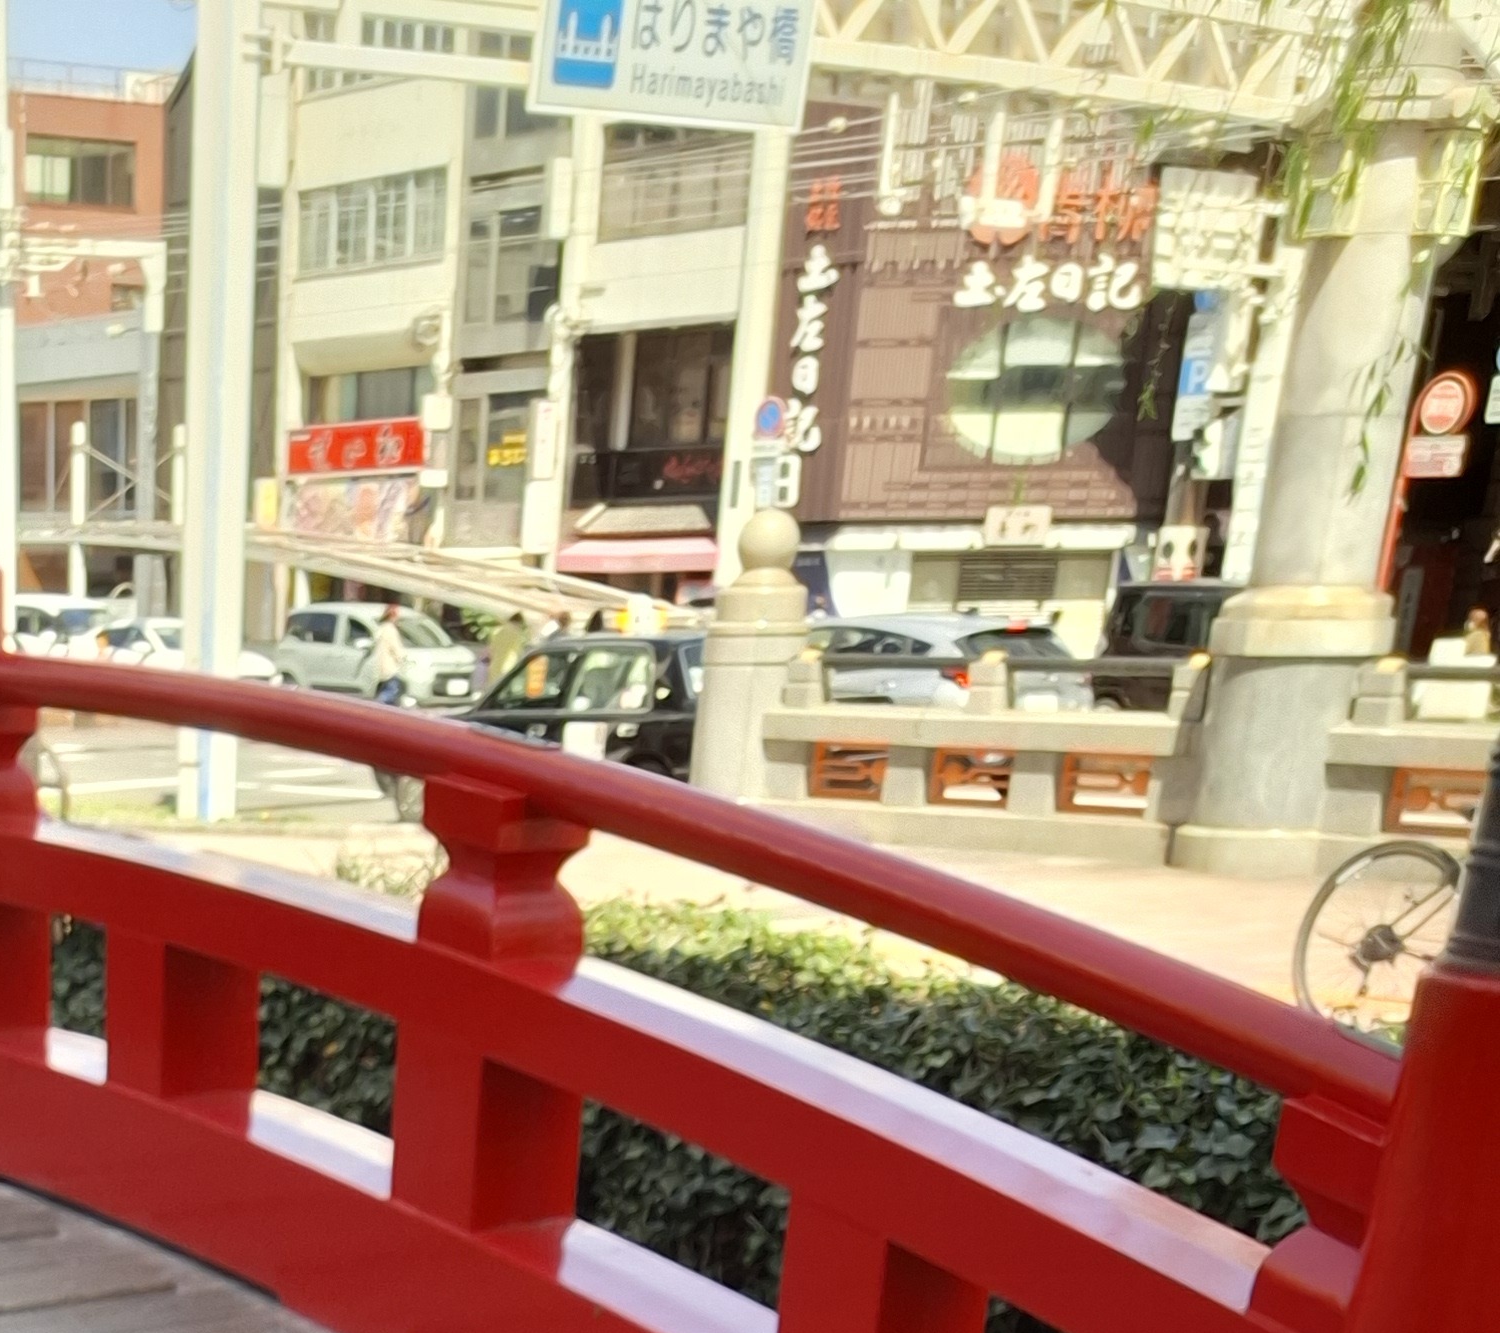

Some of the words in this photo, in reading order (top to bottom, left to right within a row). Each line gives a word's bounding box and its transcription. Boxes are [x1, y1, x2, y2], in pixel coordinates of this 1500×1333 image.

[632, 0, 799, 64] はりまや橋
[629, 63, 786, 107] Harimayabashi
